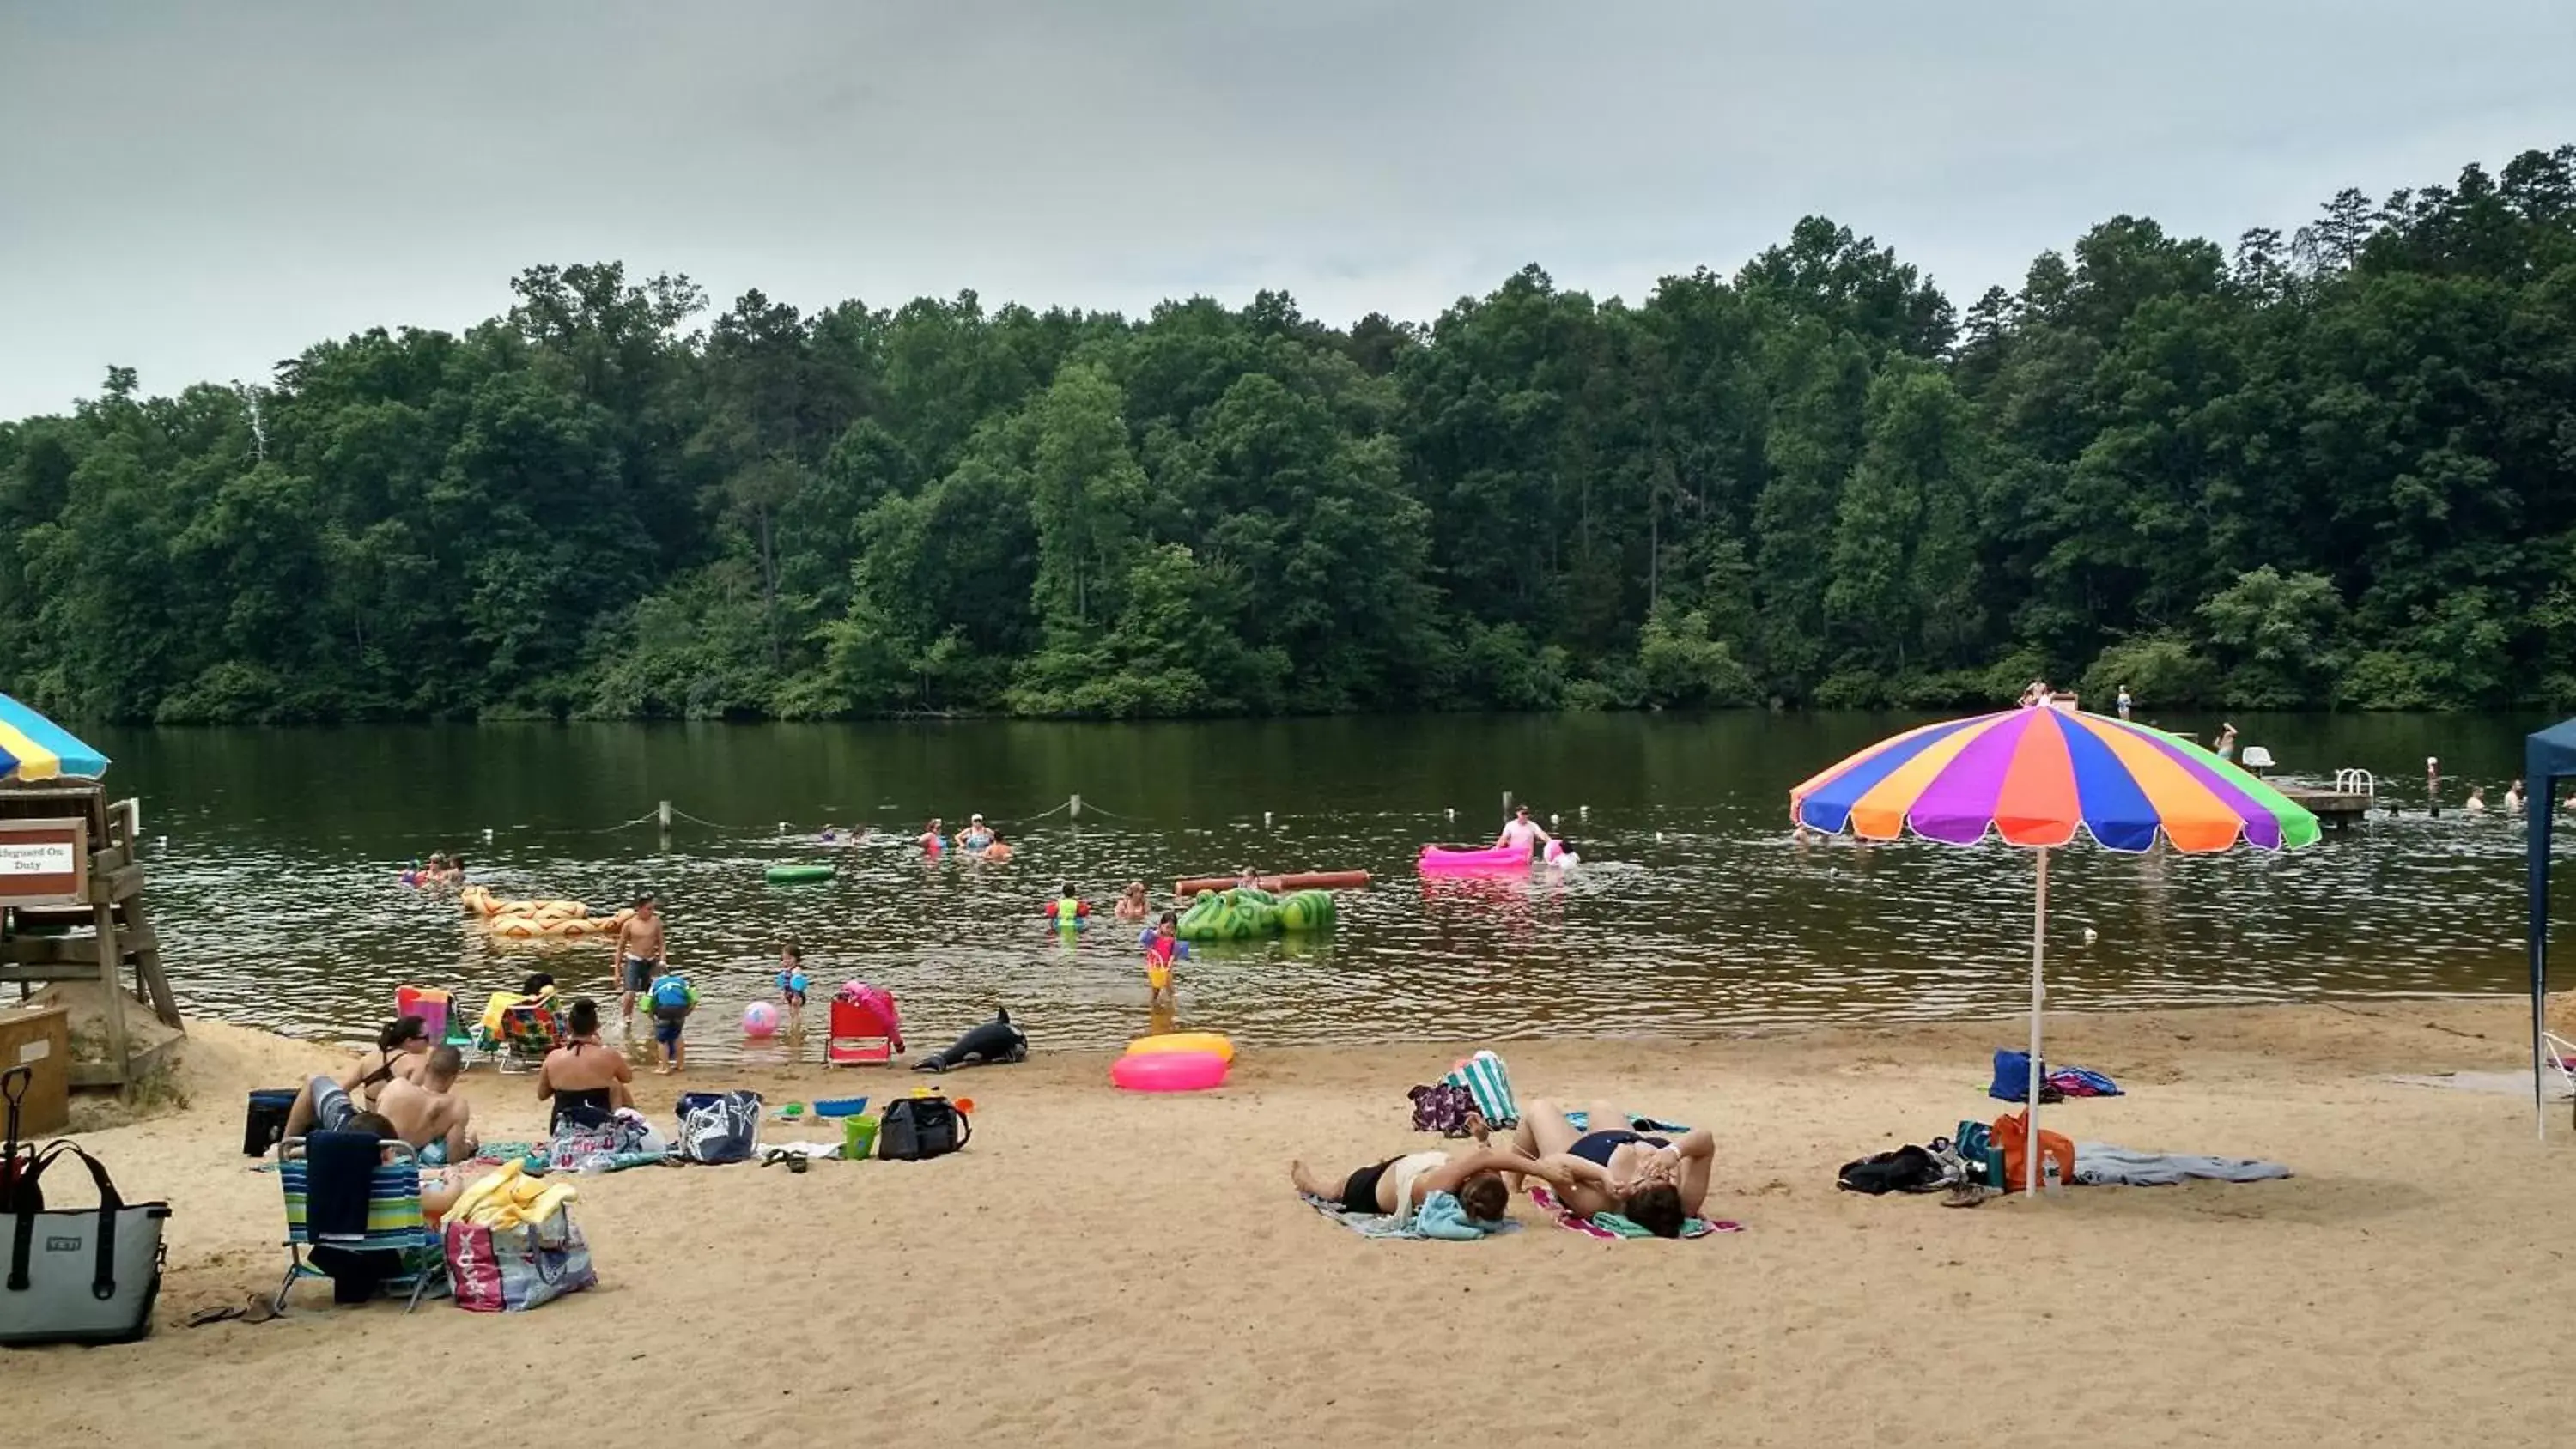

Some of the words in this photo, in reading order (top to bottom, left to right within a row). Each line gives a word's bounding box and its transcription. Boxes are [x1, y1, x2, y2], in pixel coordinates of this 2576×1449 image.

[47, 847, 64, 856] On
[15, 861, 41, 870] Duty
[50, 1239, 80, 1251] YETI
